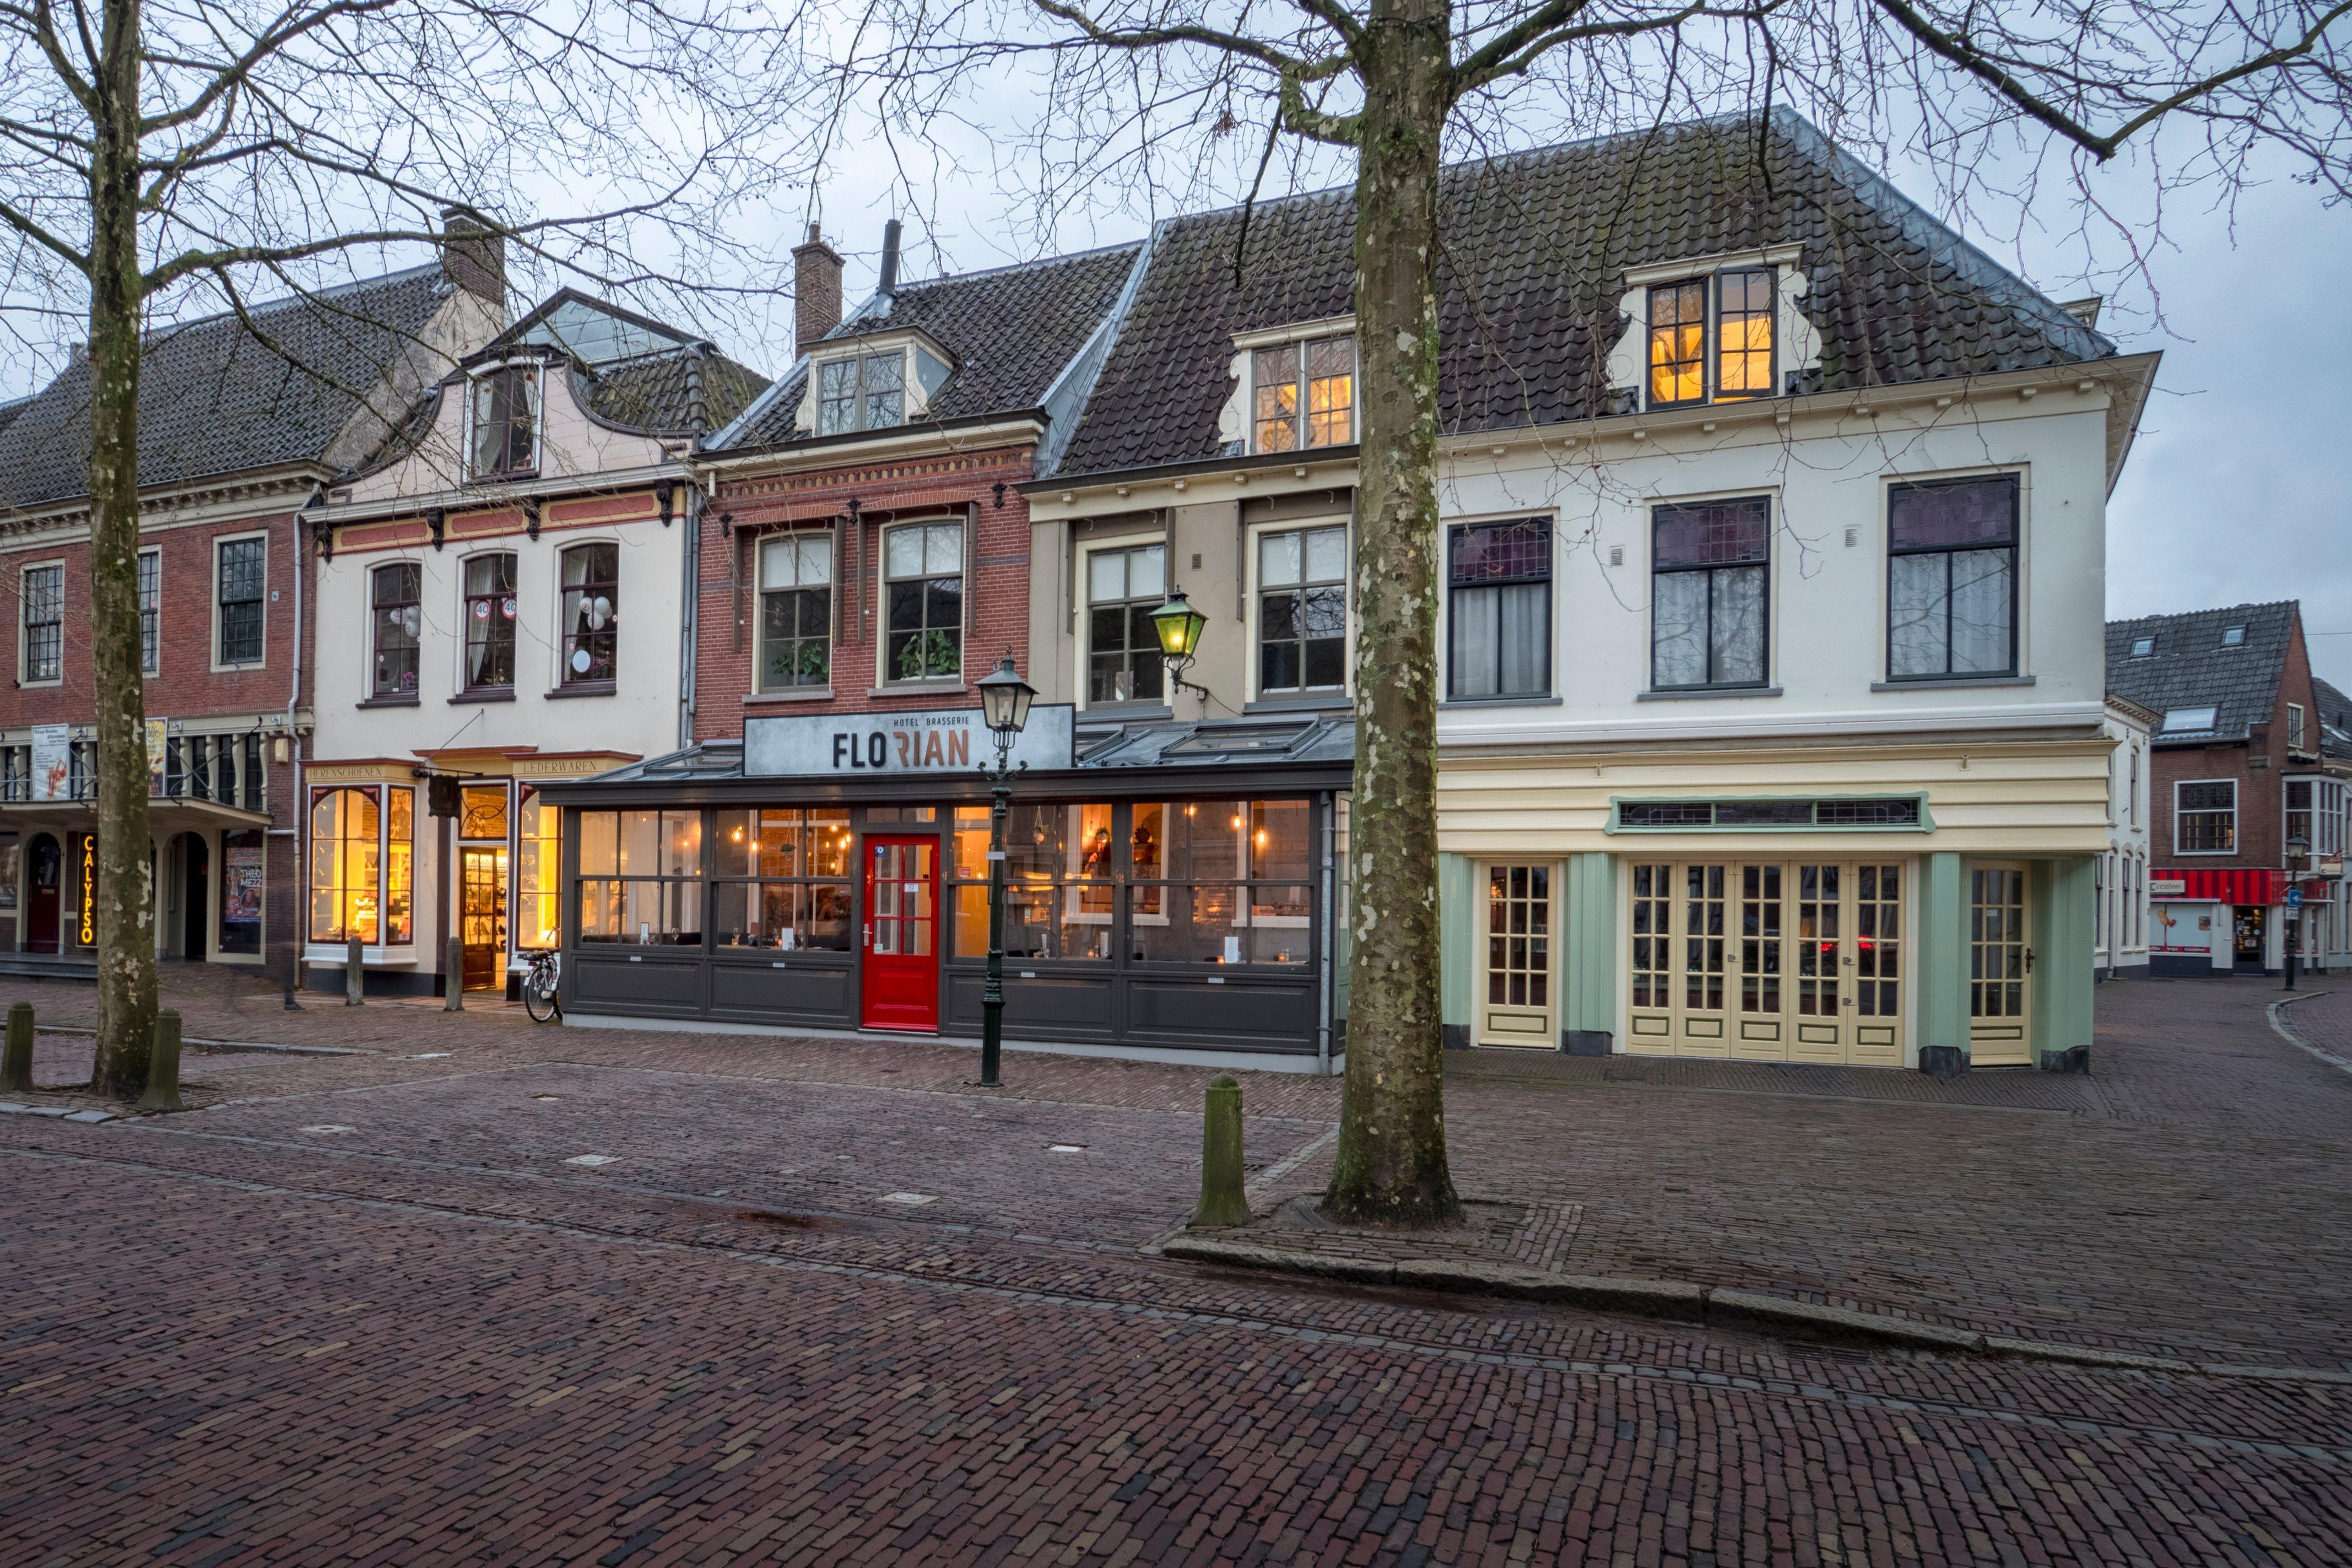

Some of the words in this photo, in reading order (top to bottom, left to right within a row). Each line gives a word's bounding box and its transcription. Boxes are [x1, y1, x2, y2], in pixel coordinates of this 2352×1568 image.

[477, 604, 489, 614] 40
[505, 603, 517, 612] 40
[894, 718, 919, 727] HOTEL
[926, 716, 970, 726] BRASSERIE
[832, 729, 969, 768] FLORIAN
[309, 766, 382, 778] HERENSCHOENEN
[523, 760, 597, 773] LEDERWAREN
[240, 869, 262, 878] THEO
[82, 835, 94, 944] CALYPSO
